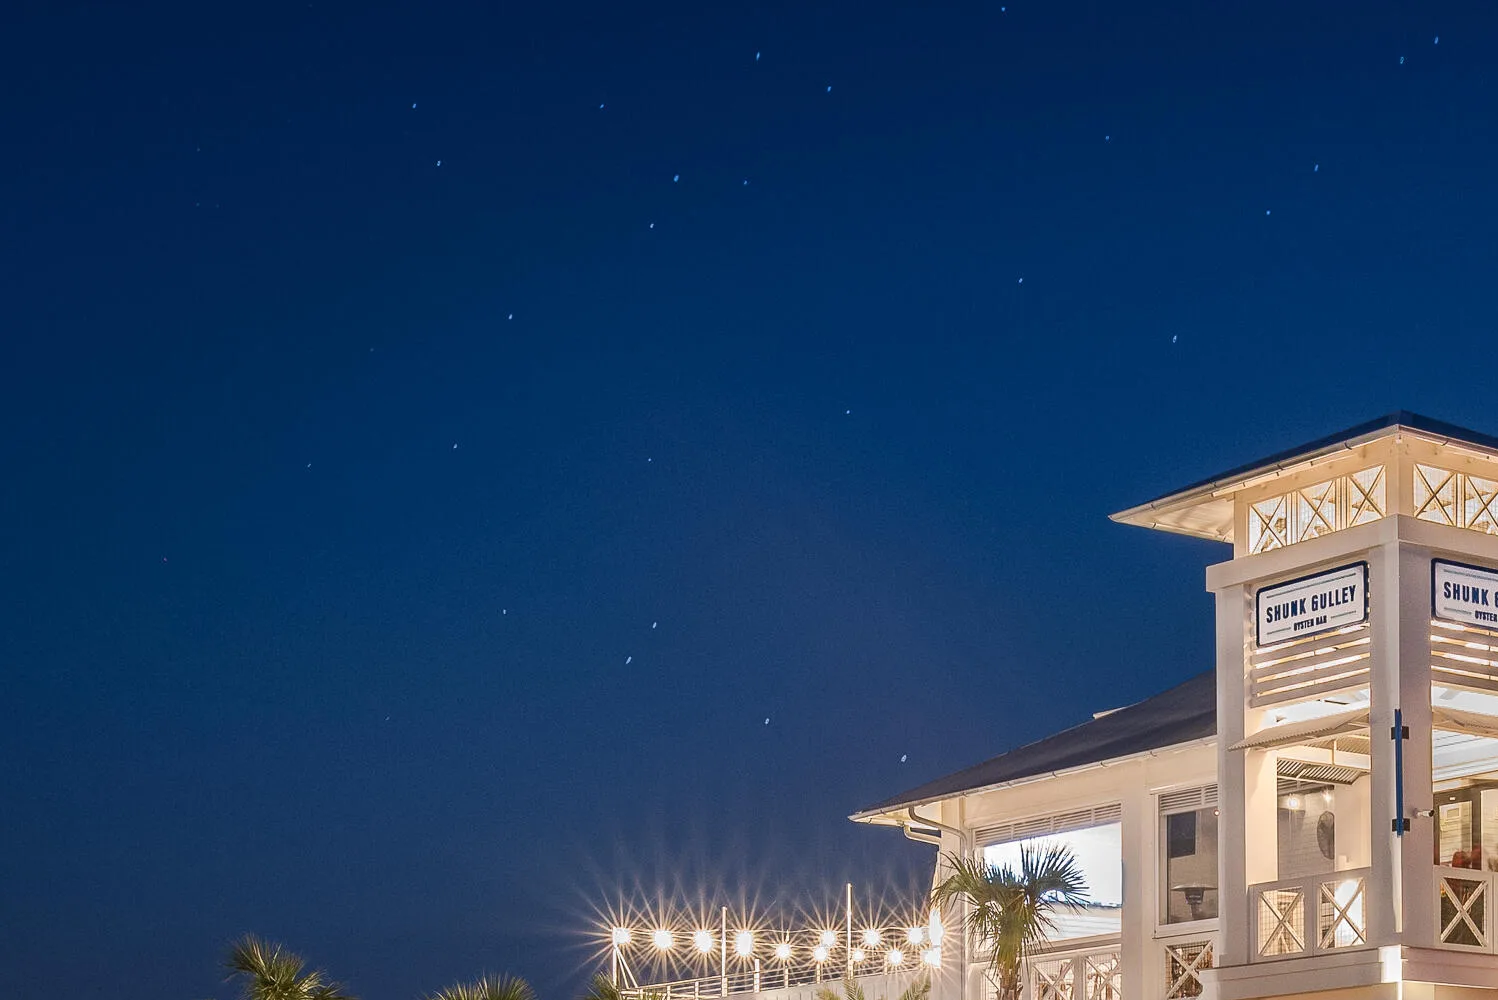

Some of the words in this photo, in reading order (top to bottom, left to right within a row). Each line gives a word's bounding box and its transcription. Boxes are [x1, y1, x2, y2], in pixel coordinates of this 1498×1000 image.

[1266, 598, 1306, 623] SHUNK
[1311, 584, 1356, 612] GULLEY
[1444, 582, 1489, 606] SHUNK
[1293, 618, 1314, 631] OYSTER
[1316, 615, 1327, 625] BAR
[1474, 610, 1497, 622] OYSTER
